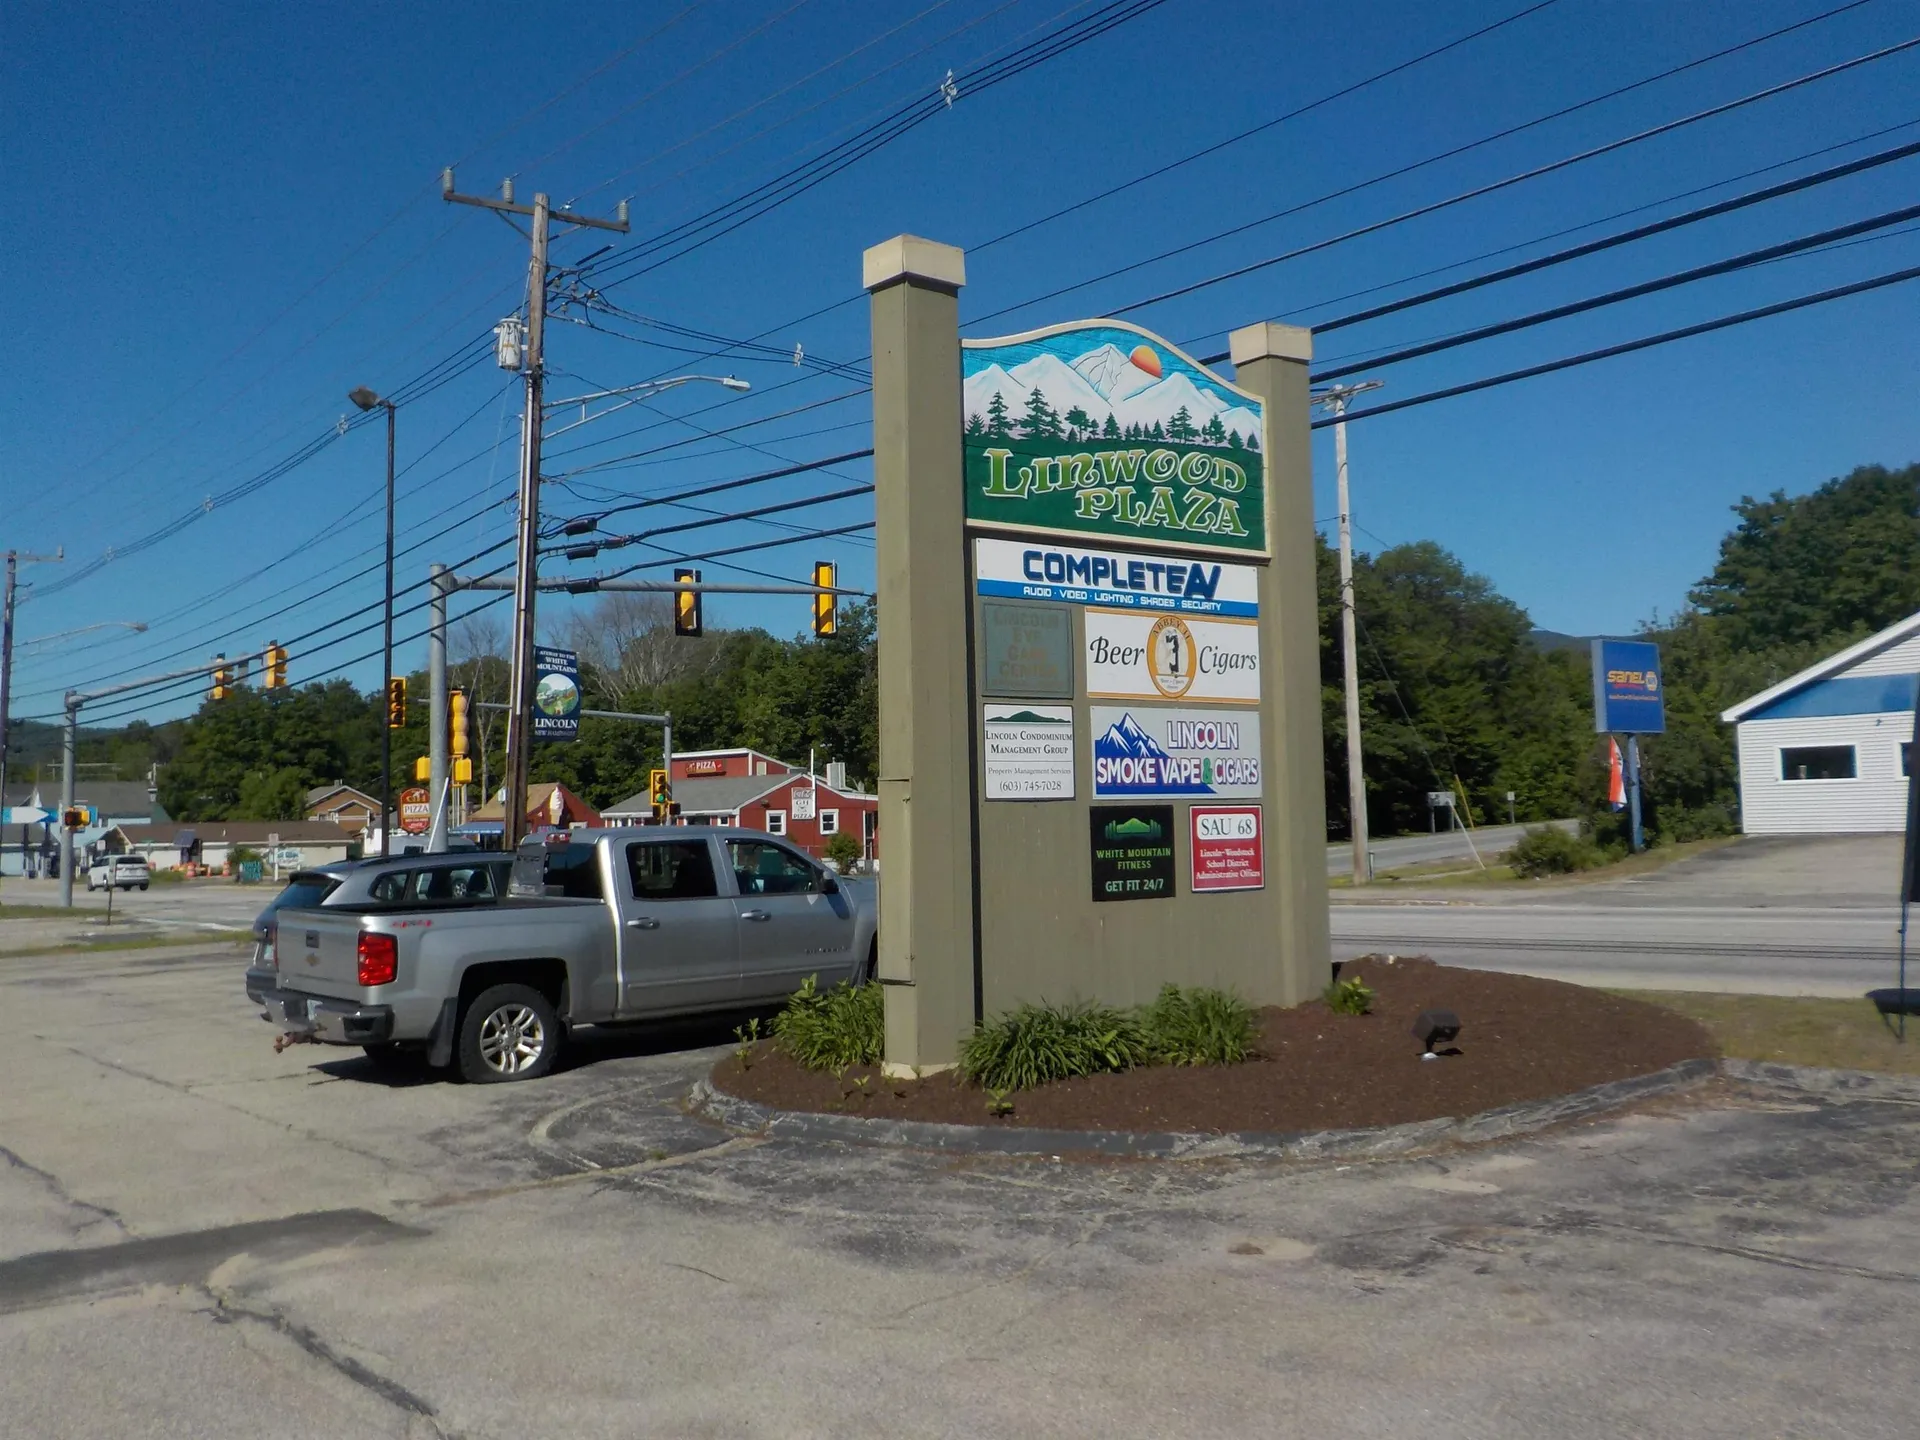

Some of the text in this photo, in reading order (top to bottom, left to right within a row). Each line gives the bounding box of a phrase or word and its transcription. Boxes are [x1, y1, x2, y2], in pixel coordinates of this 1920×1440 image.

[1075, 486, 1249, 536] PLAZA
[1023, 586, 1221, 611] AUDIO VIDEO LIGHTING SHADES SECURITY
[1090, 636, 1145, 666] Beer
[545, 656, 568, 665] WHITE
[1199, 645, 1257, 675] Cigars
[537, 663, 578, 673] MOUNTAINS
[535, 718, 578, 729] LINCOLN
[986, 730, 1072, 740] LINCOLN CONDOMINIUM
[1167, 721, 1239, 750] LINCOLN
[991, 744, 1068, 754] MANAGEMENT GROUP
[696, 761, 716, 769] PIZZA
[1096, 757, 1259, 785] SMOKE VAPE & CIGARS
[1000, 781, 1062, 792] (603) 745-7028
[405, 805, 428, 813] PIZZA
[1201, 818, 1252, 836] SAU 68
[1096, 848, 1171, 859] WHITE MOUNTAIN
[1117, 860, 1151, 870] FITNESS
[1206, 859, 1249, 868] School District
[1105, 878, 1164, 892] GET FIT 24/7
